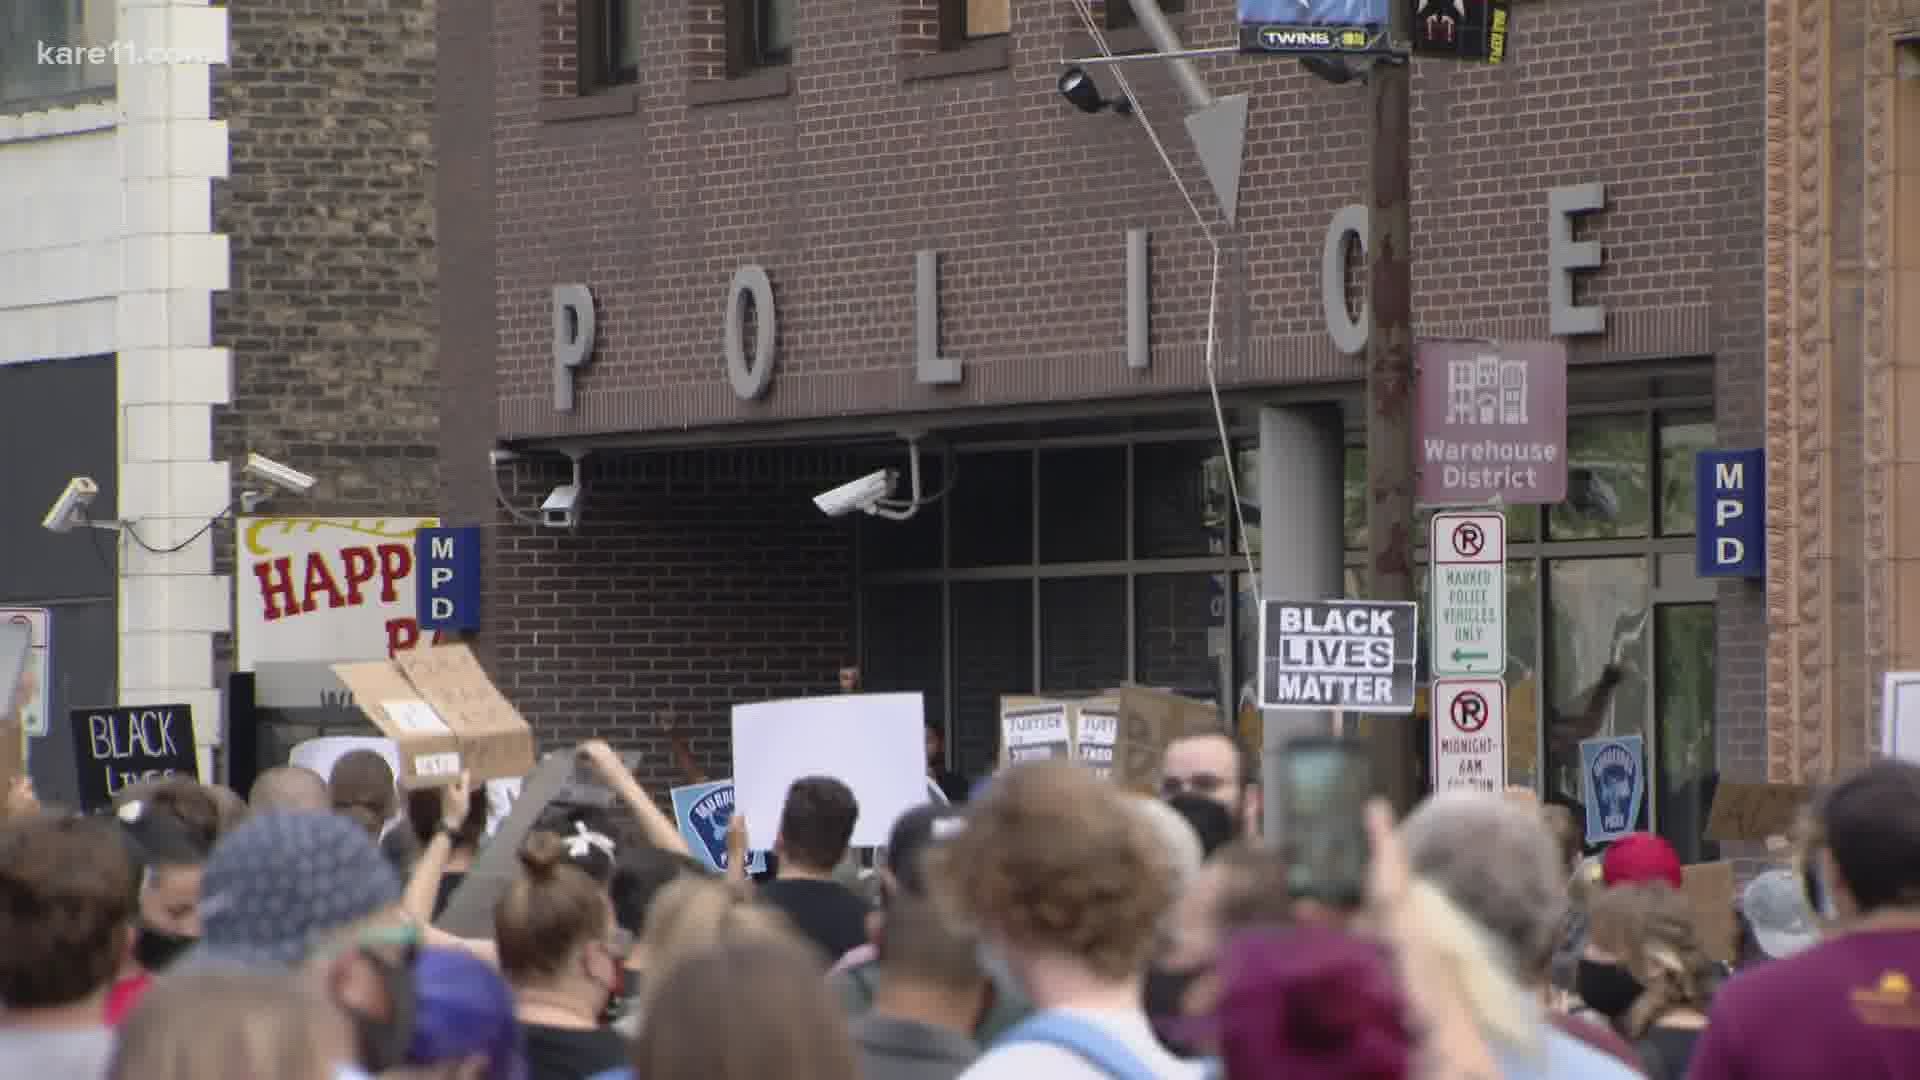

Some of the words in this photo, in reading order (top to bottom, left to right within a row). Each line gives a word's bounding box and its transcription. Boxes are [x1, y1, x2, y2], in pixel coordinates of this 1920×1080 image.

[1263, 32, 1329, 45] TWINS
[552, 182, 1606, 411] POLICE
[1424, 439, 1556, 463] Warehouse
[1443, 466, 1537, 489] District
[1716, 463, 1745, 564] MPD
[254, 544, 413, 621] HAPP
[431, 536, 454, 619] MPD
[1450, 588, 1488, 605] POLICE
[1280, 607, 1393, 634] BLACK
[1455, 625, 1482, 641] ONLY
[1282, 639, 1391, 668] LIVES
[1279, 674, 1393, 703] MATTER
[89, 711, 176, 759] BLACK
